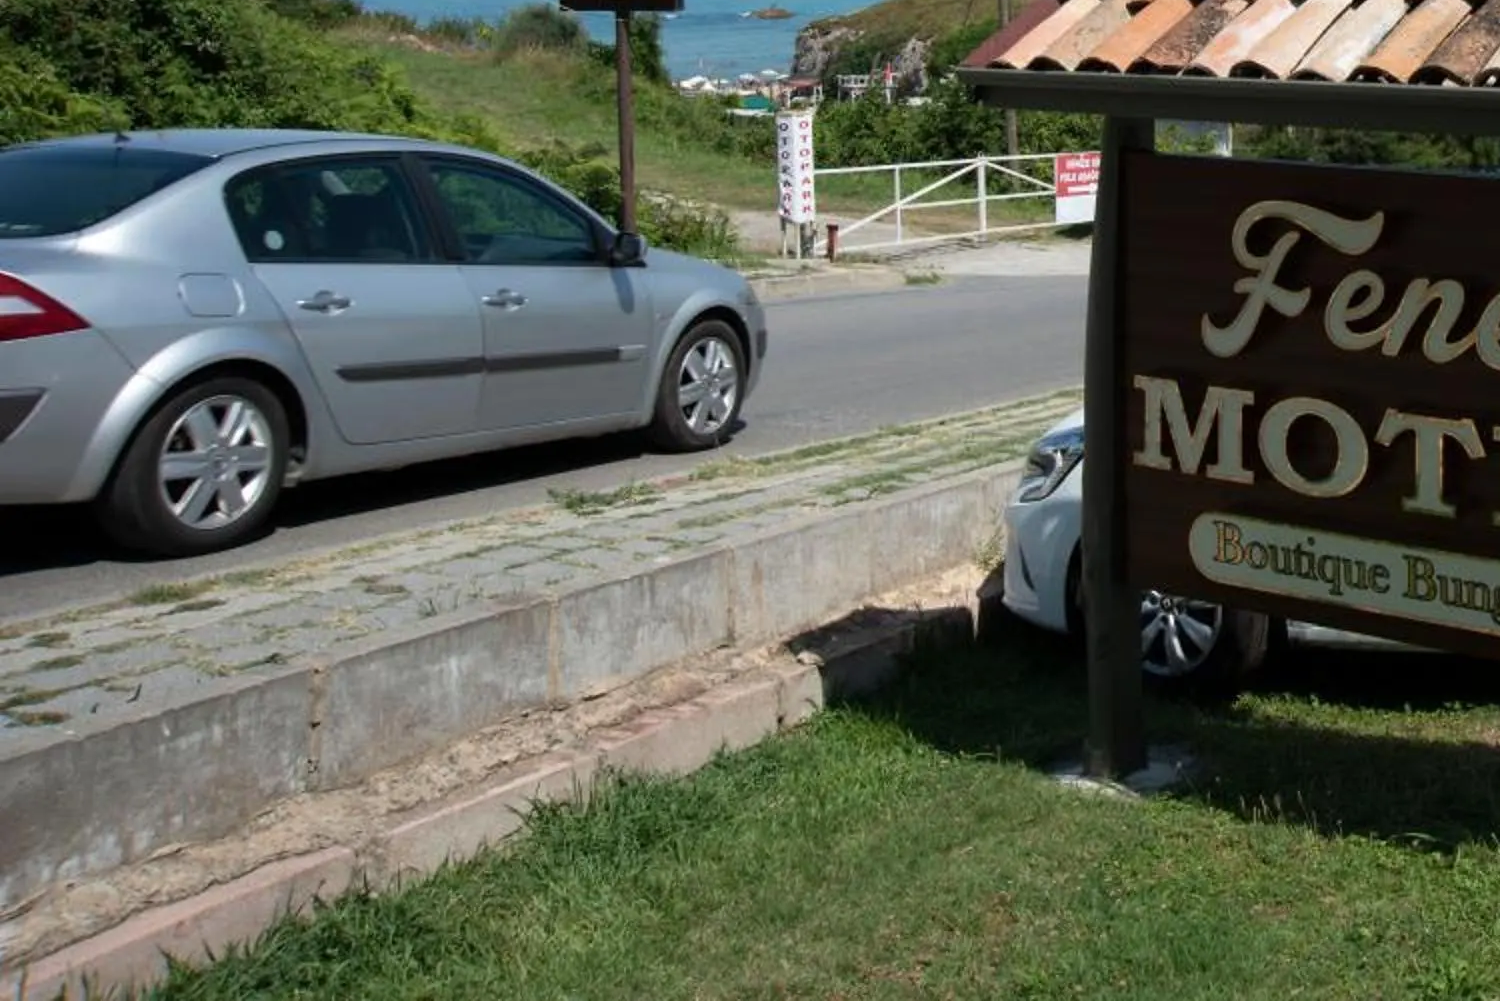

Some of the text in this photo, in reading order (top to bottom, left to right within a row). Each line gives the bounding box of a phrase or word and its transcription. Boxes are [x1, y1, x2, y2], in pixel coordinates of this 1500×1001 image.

[779, 122, 792, 216] OTOPARK
[799, 120, 812, 213] OTOPARK
[1212, 521, 1391, 596] Boutique
